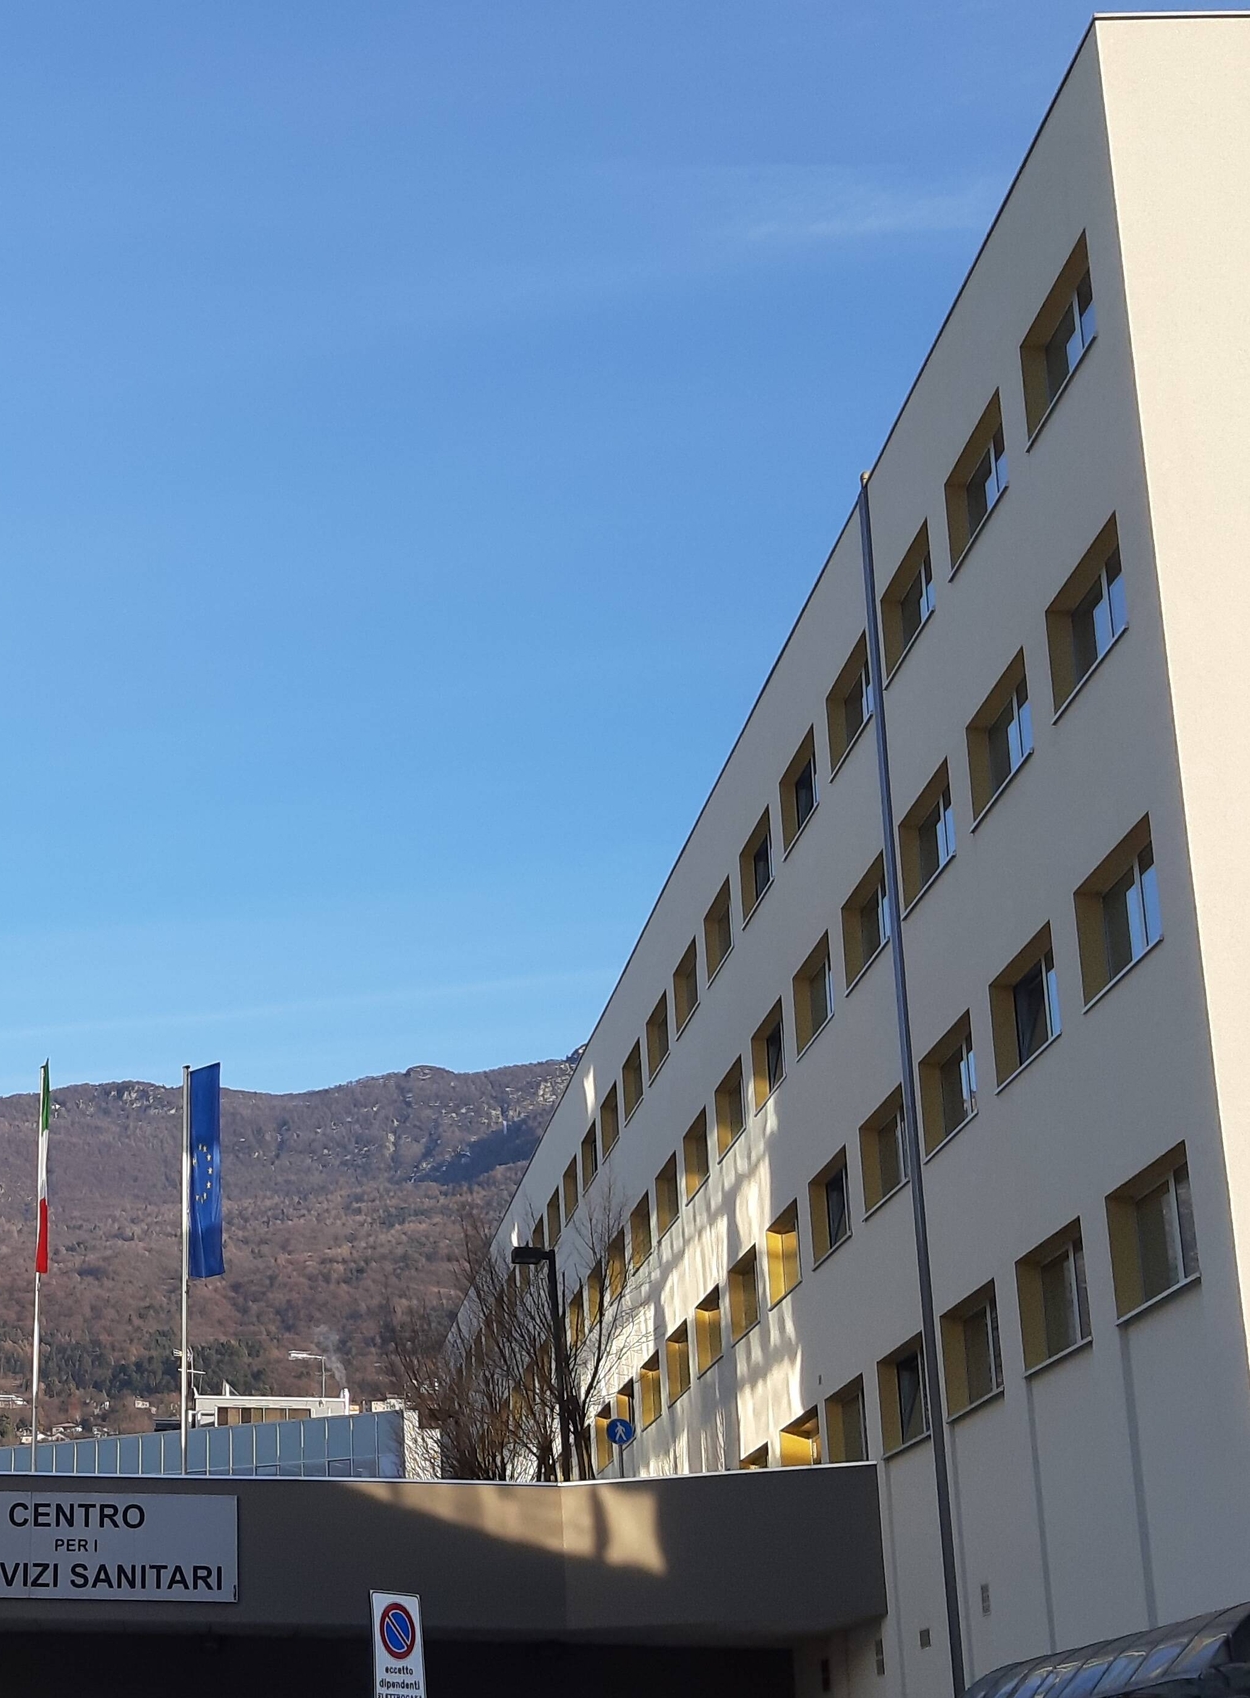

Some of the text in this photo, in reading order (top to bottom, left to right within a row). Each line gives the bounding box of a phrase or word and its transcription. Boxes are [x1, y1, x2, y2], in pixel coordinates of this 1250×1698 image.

[8, 1502, 146, 1529] CENTRO
[54, 1538, 89, 1553] PER
[70, 1563, 223, 1591] SANITARI
[385, 1665, 414, 1676] eccetto
[379, 1678, 420, 1691] dipendenti
